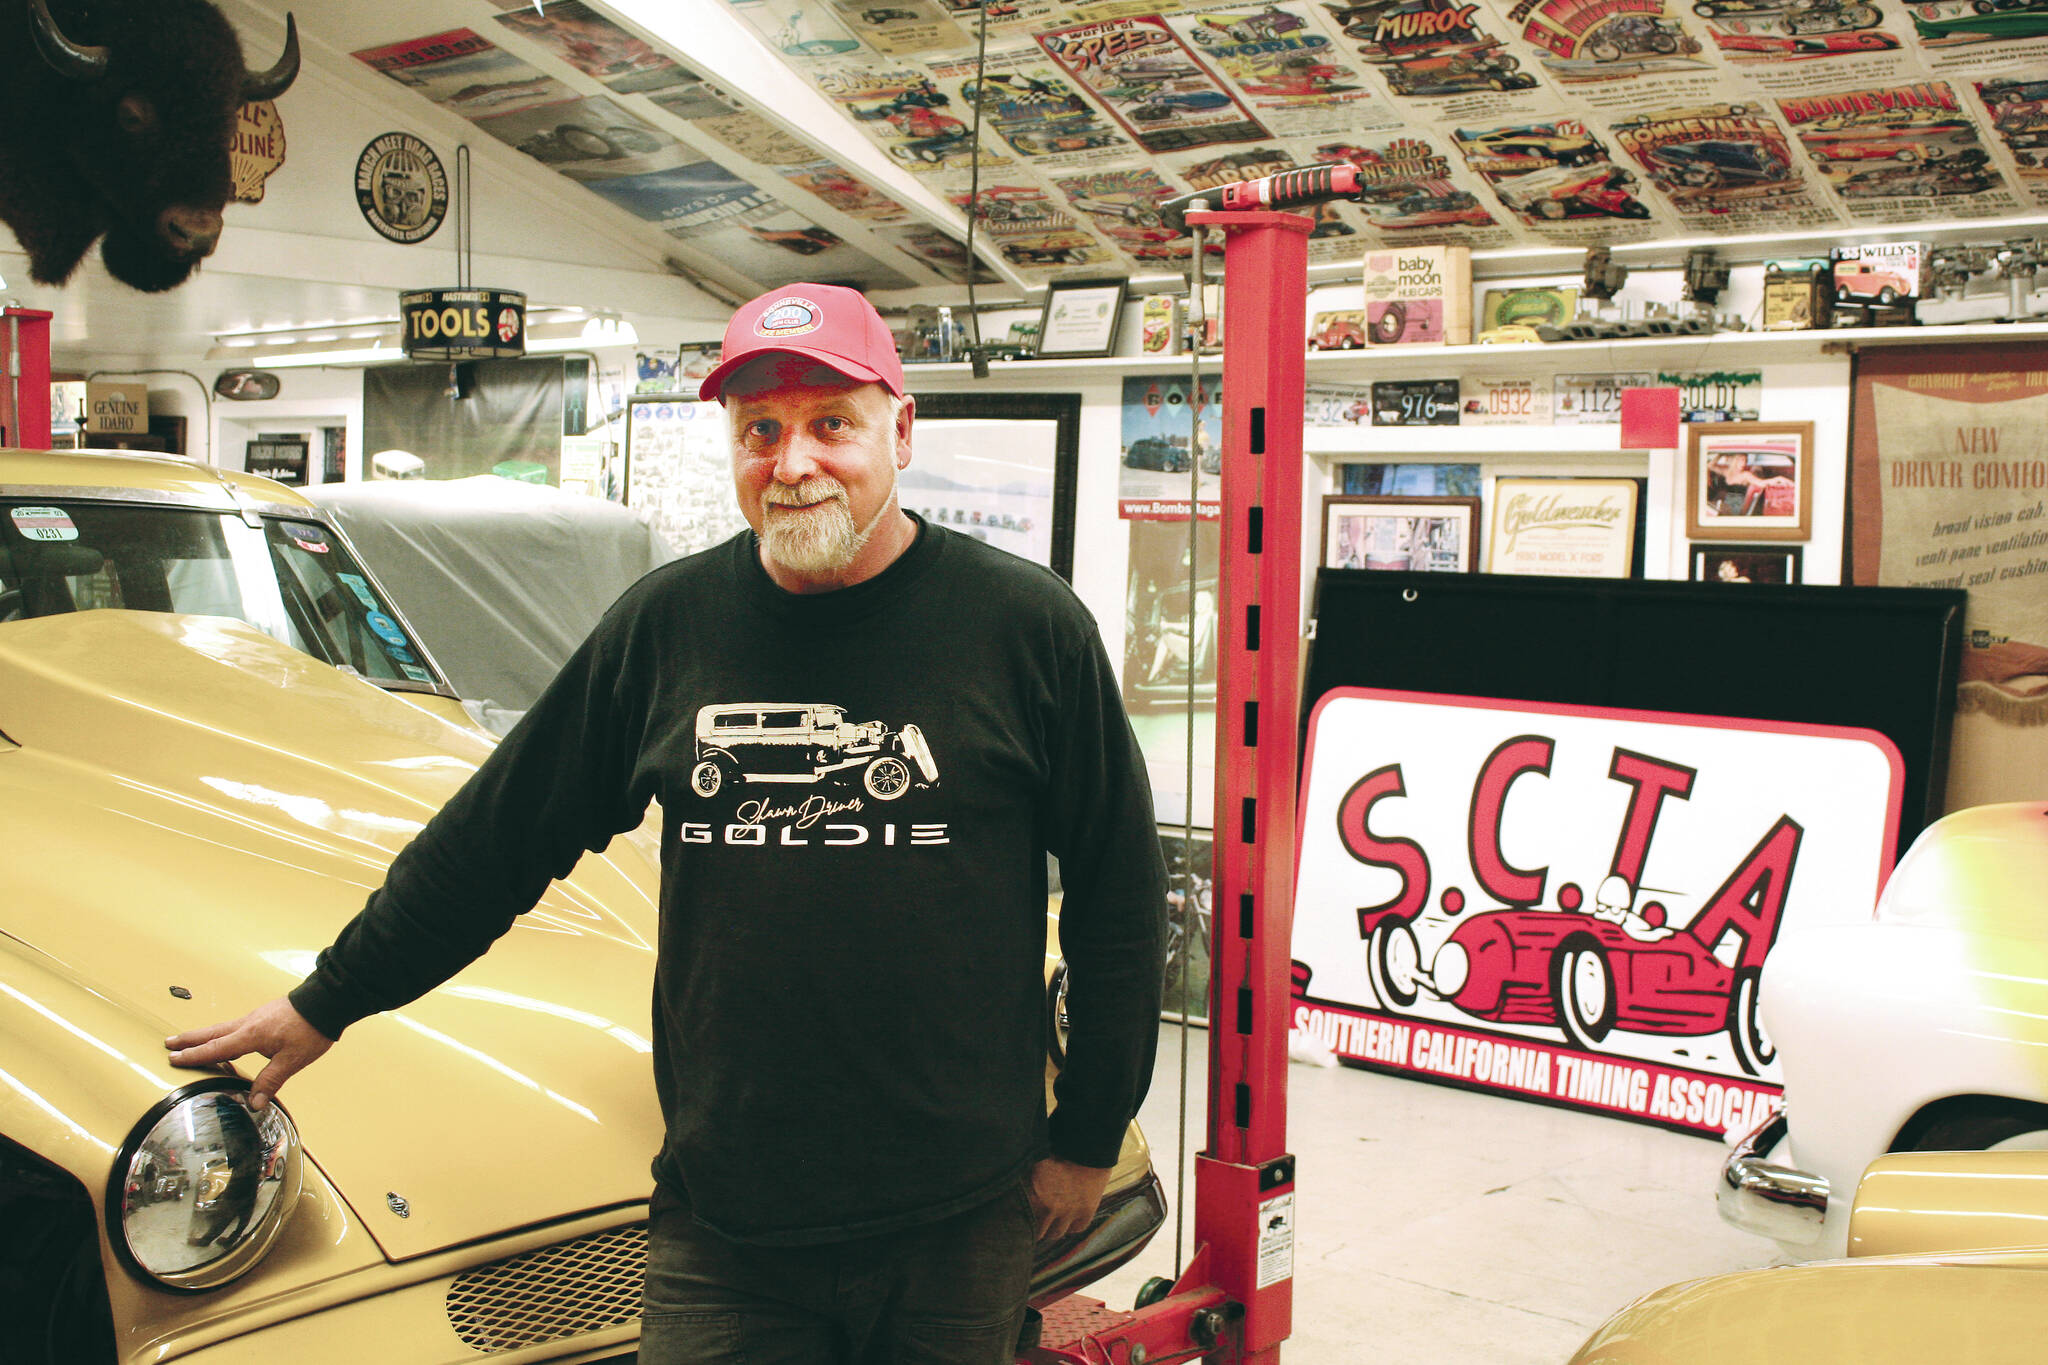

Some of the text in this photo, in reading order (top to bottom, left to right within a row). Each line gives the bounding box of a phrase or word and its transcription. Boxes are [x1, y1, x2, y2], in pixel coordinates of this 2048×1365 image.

[1374, 3, 1480, 43] MUROC
[1062, 30, 1173, 73] SPEED
[1398, 255, 1434, 273] baby
[1863, 244, 1917, 258] WILLY'S
[1398, 272, 1442, 286] moon
[762, 298, 817, 318] BONNEVILLE
[411, 307, 491, 339] TOOLS
[94, 401, 139, 416] GENUINE
[1402, 393, 1437, 419] 976
[1490, 388, 1532, 415] 0932
[100, 416, 134, 431] IDAHO
[1957, 427, 2000, 454] NEW
[1892, 461, 2048, 489] DRIVER COMFO
[36, 528, 63, 539] 0231
[1932, 515, 1972, 537] broad
[1973, 511, 2013, 531] vision
[681, 821, 950, 847] GOLDIE
[1294, 1006, 1410, 1065] SOUTHERN
[1411, 1028, 1551, 1093] CALIFORNIA
[1555, 1054, 1650, 1113] TIMING
